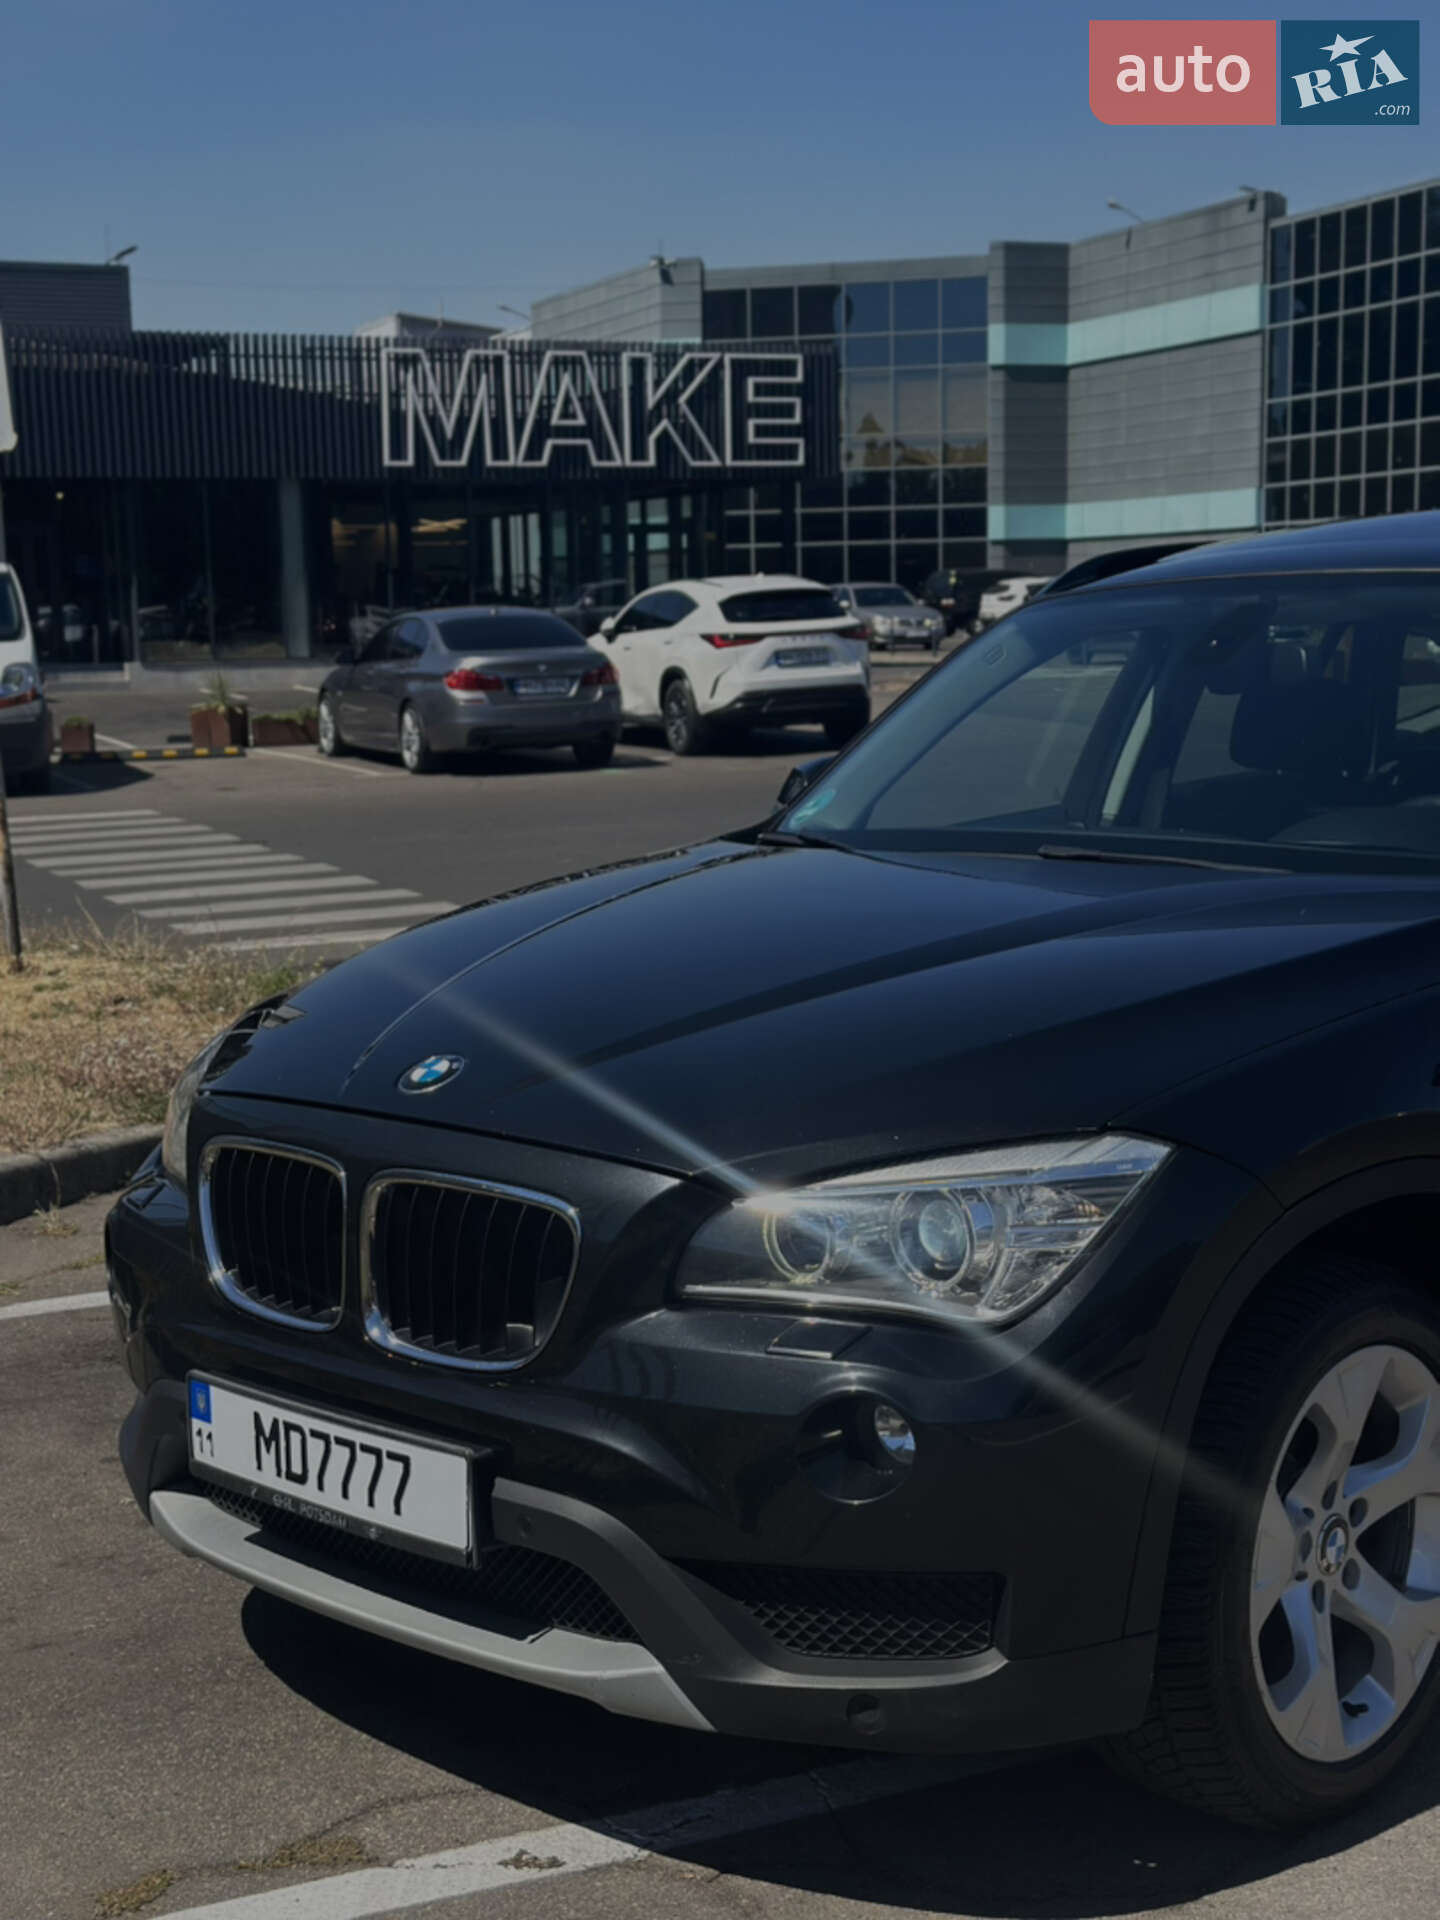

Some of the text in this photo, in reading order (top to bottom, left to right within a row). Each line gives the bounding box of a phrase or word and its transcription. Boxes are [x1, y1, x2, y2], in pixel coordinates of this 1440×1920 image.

[381, 347, 805, 467] MAKE
[195, 1427, 214, 1458] 11
[253, 1411, 411, 1516] MD7777
